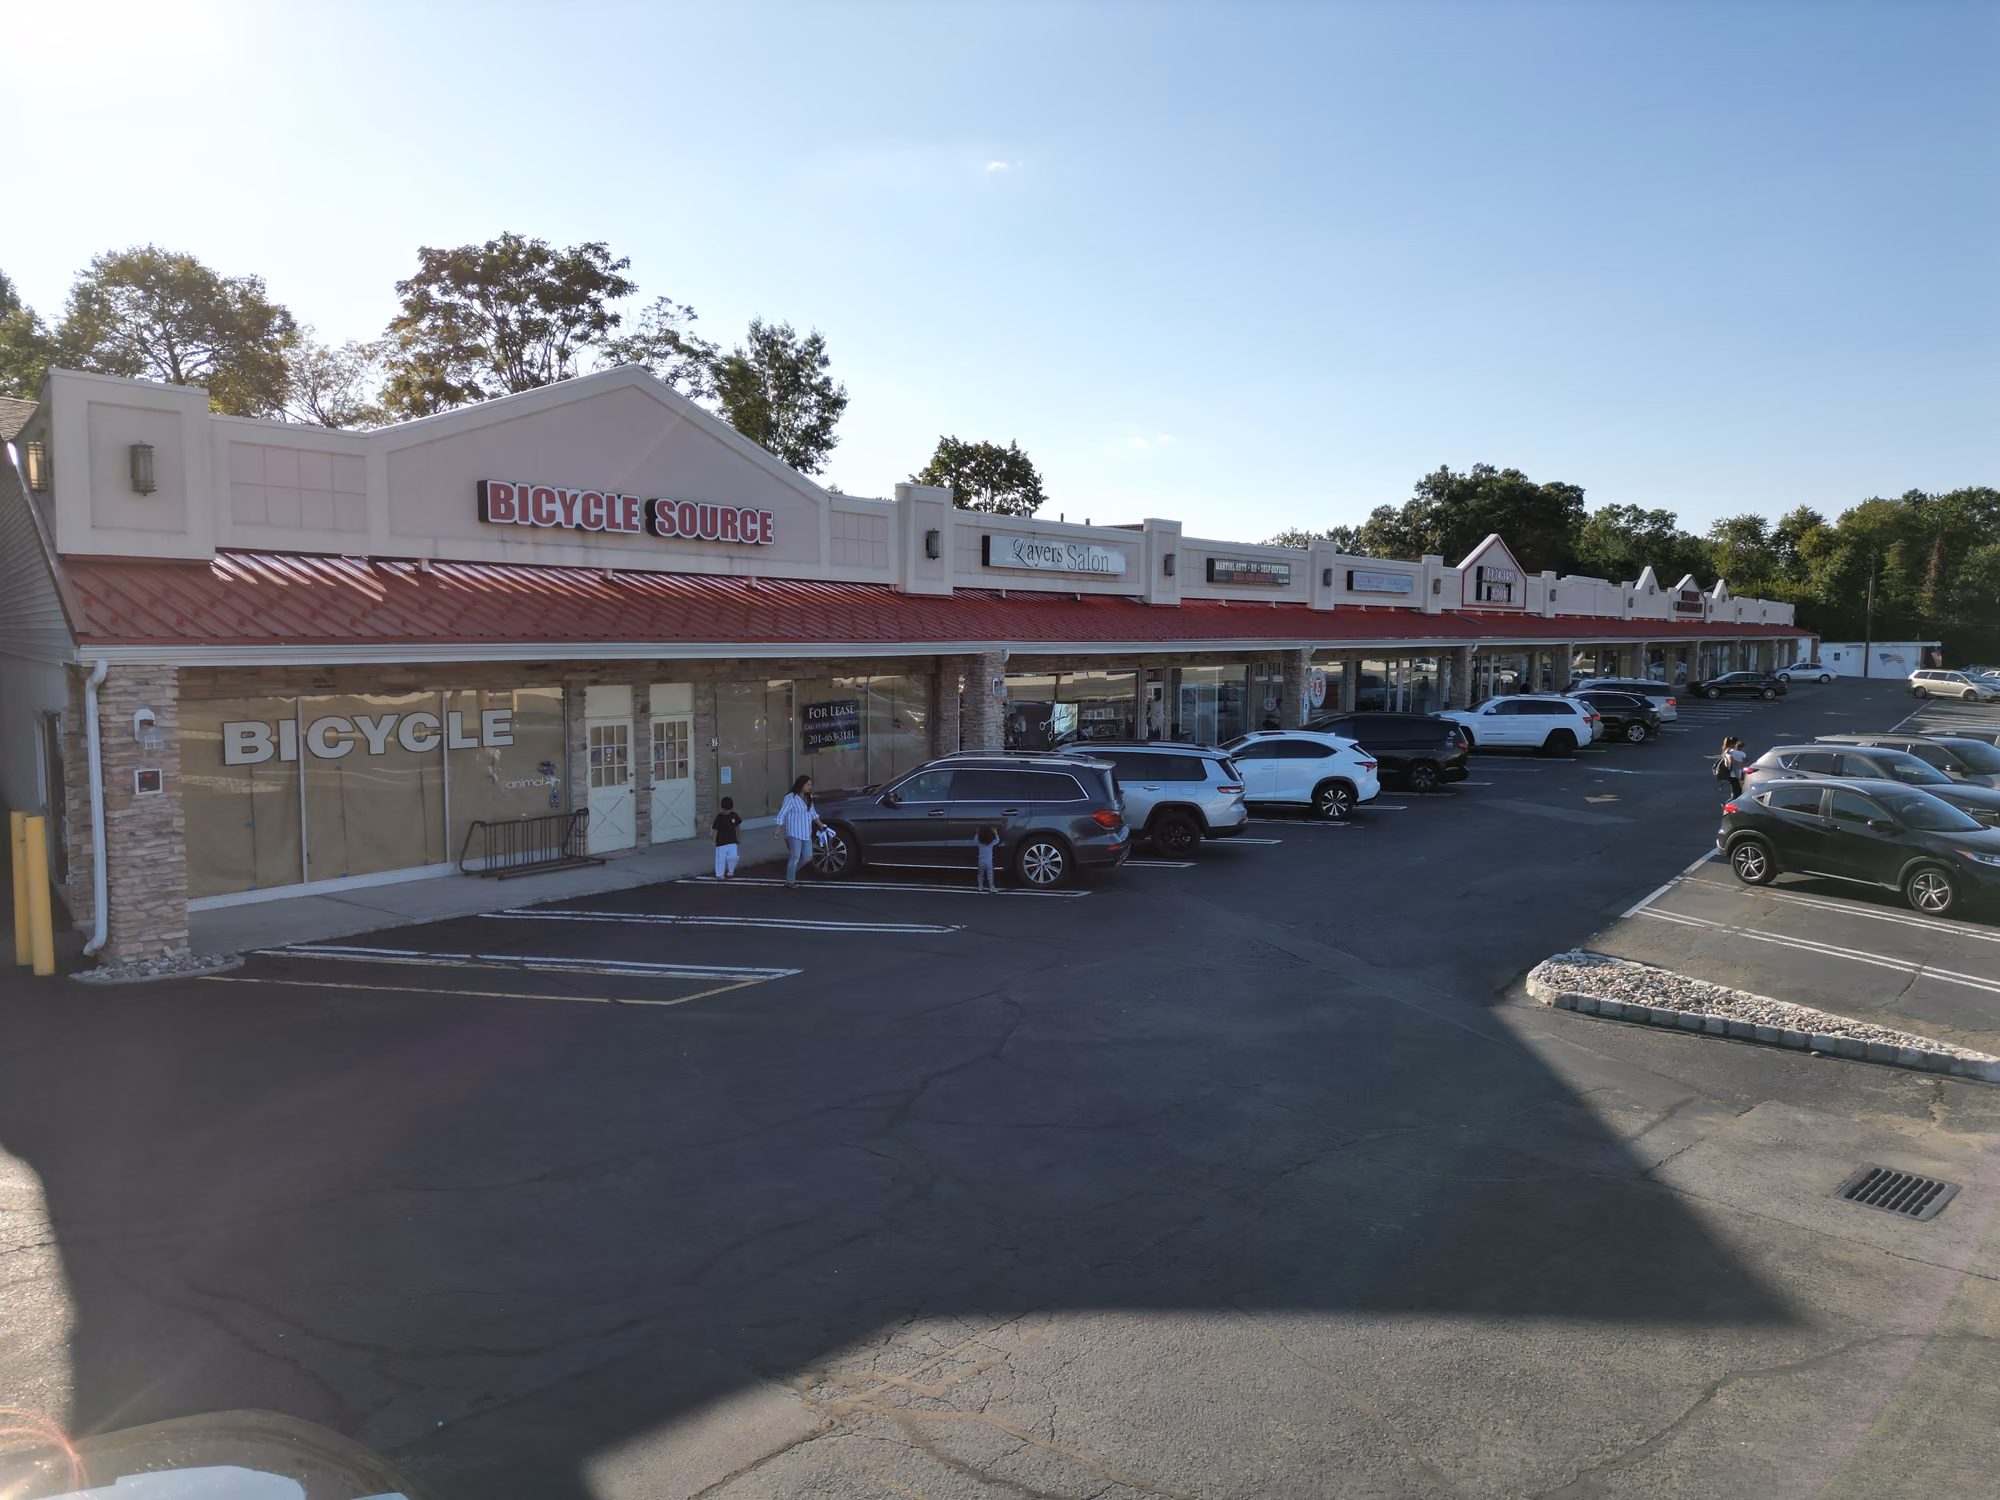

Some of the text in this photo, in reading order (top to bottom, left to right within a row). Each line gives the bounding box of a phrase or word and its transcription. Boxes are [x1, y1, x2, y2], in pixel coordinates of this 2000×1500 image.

[486, 479, 774, 545] BICYCLE SOURCE
[1012, 538, 1110, 572] Layers Salon
[1215, 561, 1235, 571] MARTIAL
[1236, 562, 1247, 572] ARTS
[809, 705, 855, 719] FOR LEASE
[223, 708, 514, 765] BICYCLE
[505, 777, 545, 789] animal
